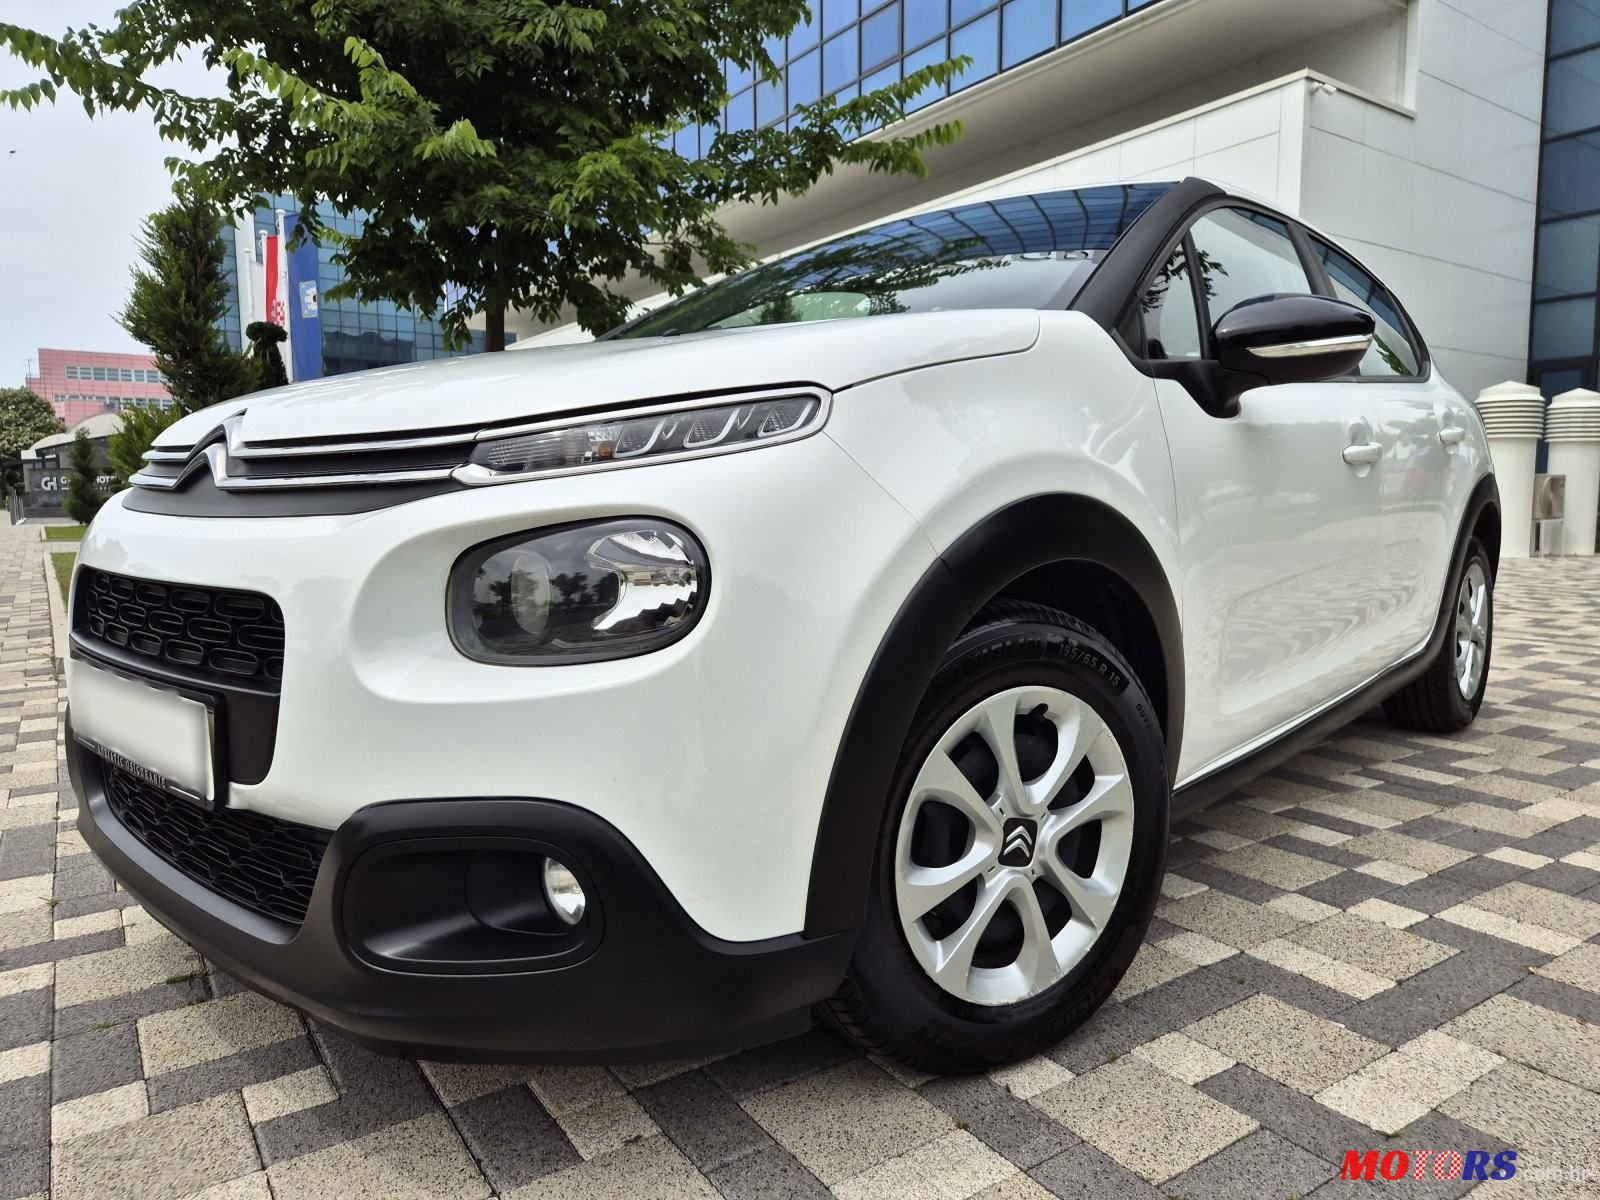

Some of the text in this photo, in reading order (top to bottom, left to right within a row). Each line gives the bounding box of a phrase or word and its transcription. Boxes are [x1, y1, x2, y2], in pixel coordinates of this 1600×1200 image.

[1059, 643, 1122, 688] 195/65 R 15
